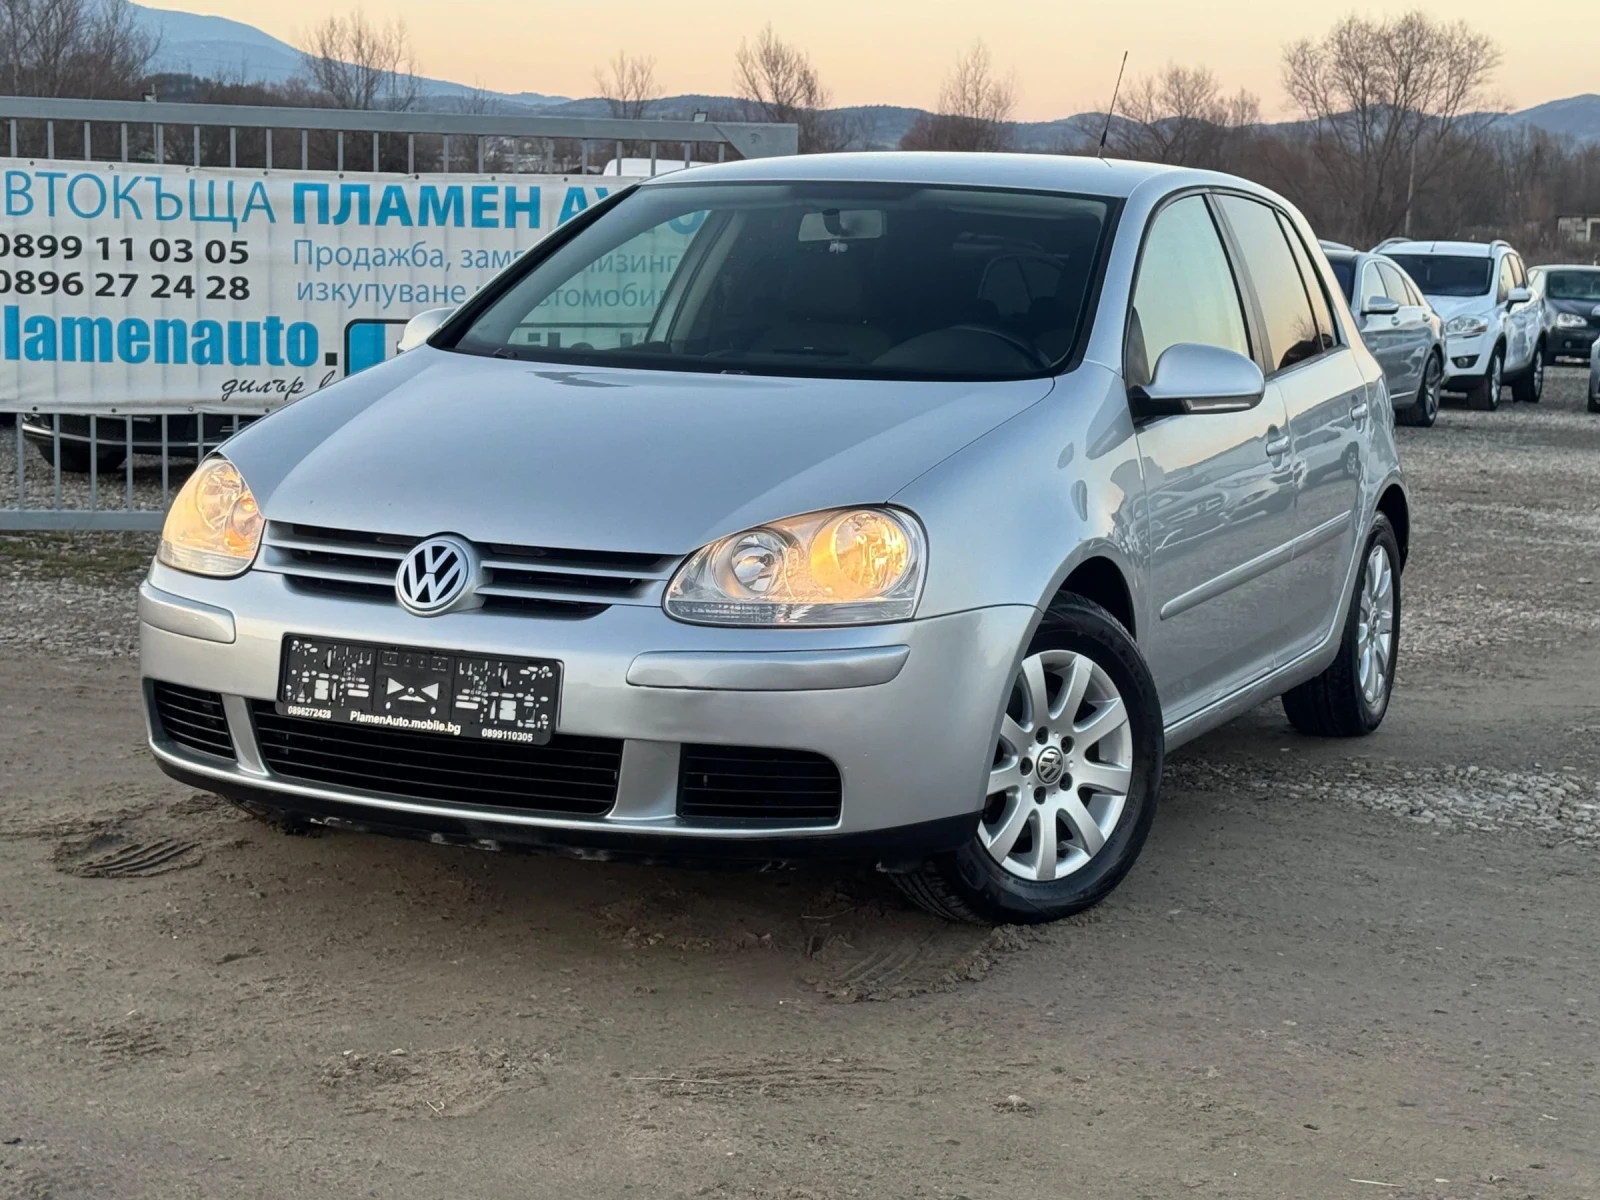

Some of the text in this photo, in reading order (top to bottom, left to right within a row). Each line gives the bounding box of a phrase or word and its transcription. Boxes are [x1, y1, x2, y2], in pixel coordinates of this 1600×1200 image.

[293, 183, 540, 229] ПЛАМЕН
[0, 233, 249, 265] 0899 11 03 05
[293, 239, 452, 273] Продажба,
[0, 269, 250, 301] 0896 27 24 28
[297, 281, 467, 310] изкупуване
[221, 375, 306, 402] дилър
[349, 710, 461, 736] PlamenAuto.mobile.bg
[481, 727, 534, 742] 0899110305
